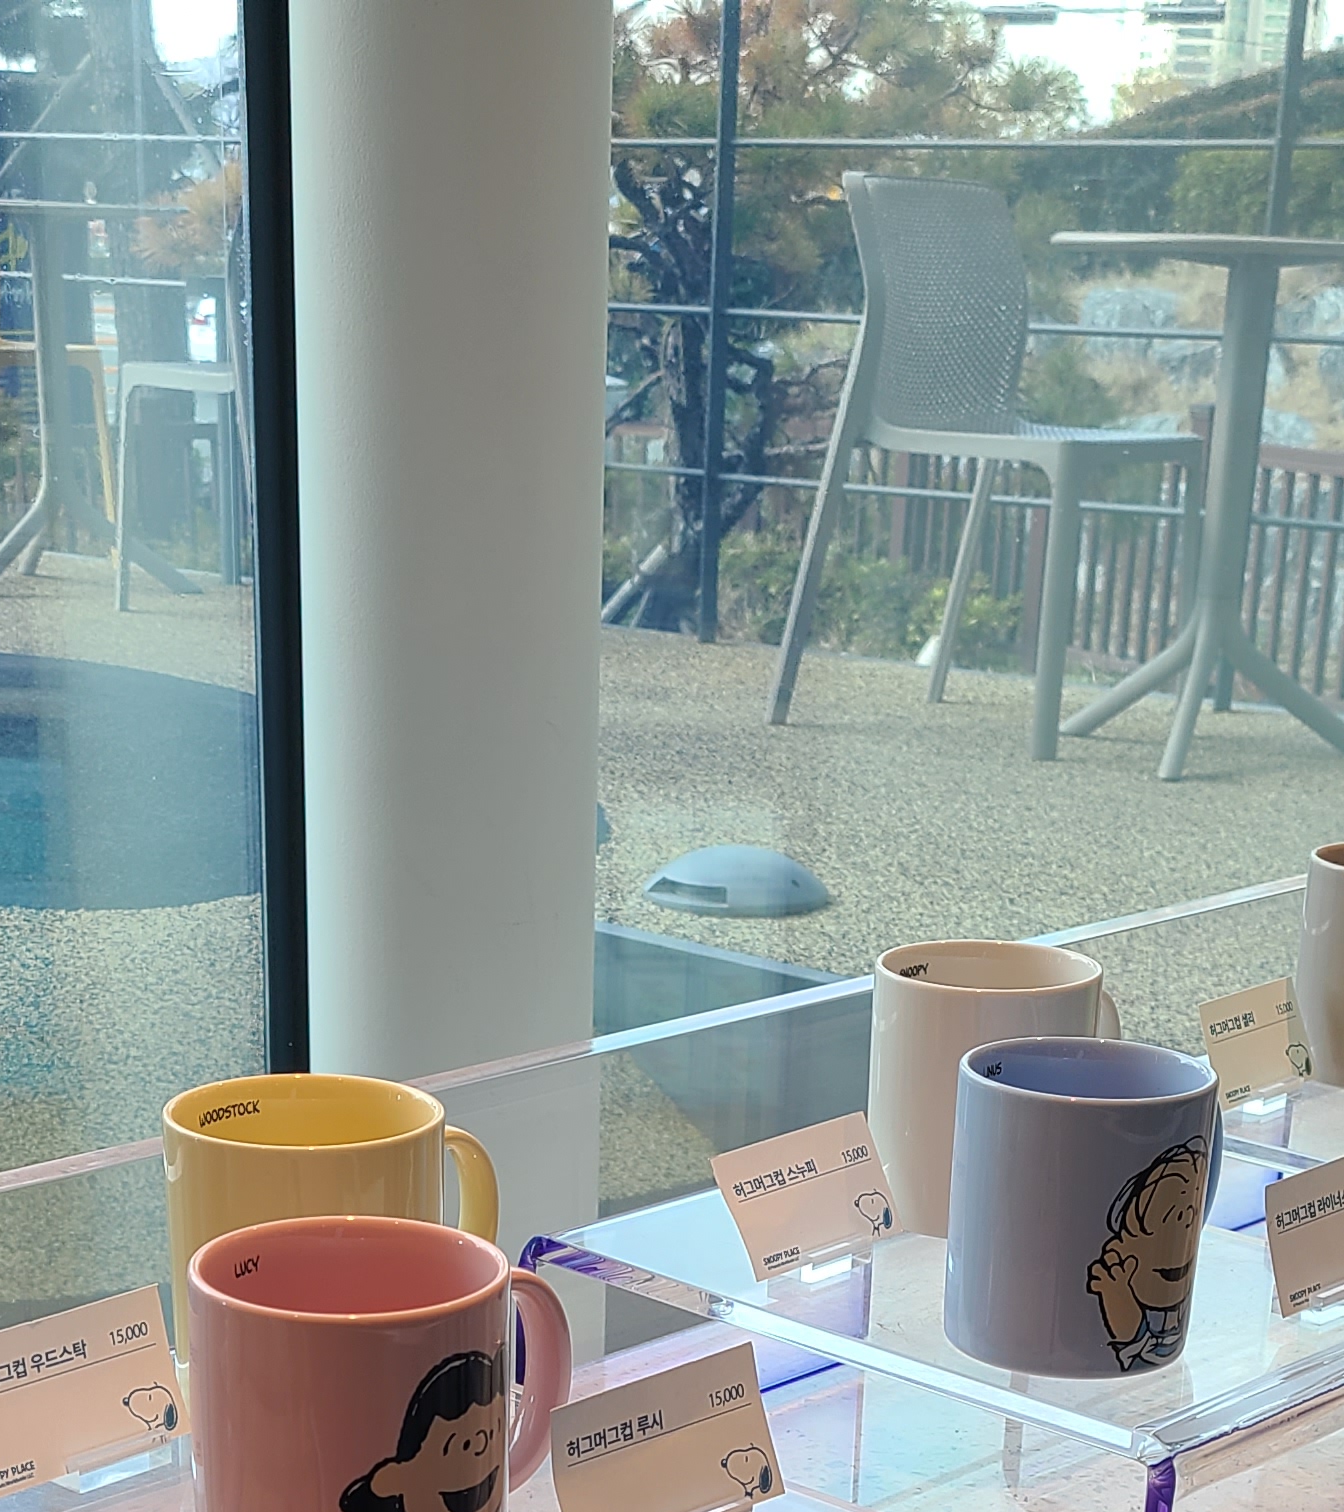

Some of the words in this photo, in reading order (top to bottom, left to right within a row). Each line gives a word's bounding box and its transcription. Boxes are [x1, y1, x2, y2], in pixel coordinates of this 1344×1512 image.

[198, 1100, 261, 1128] WOODSTOCK
[732, 1170, 787, 1198] 허그머그컵
[786, 1158, 819, 1182] 스누피
[841, 1145, 869, 1164] 15,000
[1275, 1201, 1317, 1230] 허그머그컵
[234, 1255, 261, 1279] LUCY
[763, 1253, 783, 1266] SNOOPY
[783, 1246, 801, 1259] PLACE
[30, 1339, 88, 1374] 우드스탁
[108, 1321, 149, 1346] 15,000
[566, 1419, 634, 1458] 허그머그컵
[636, 1409, 665, 1437] 루시
[708, 1383, 745, 1408] 15,000
[10, 1460, 36, 1477] PLACE
